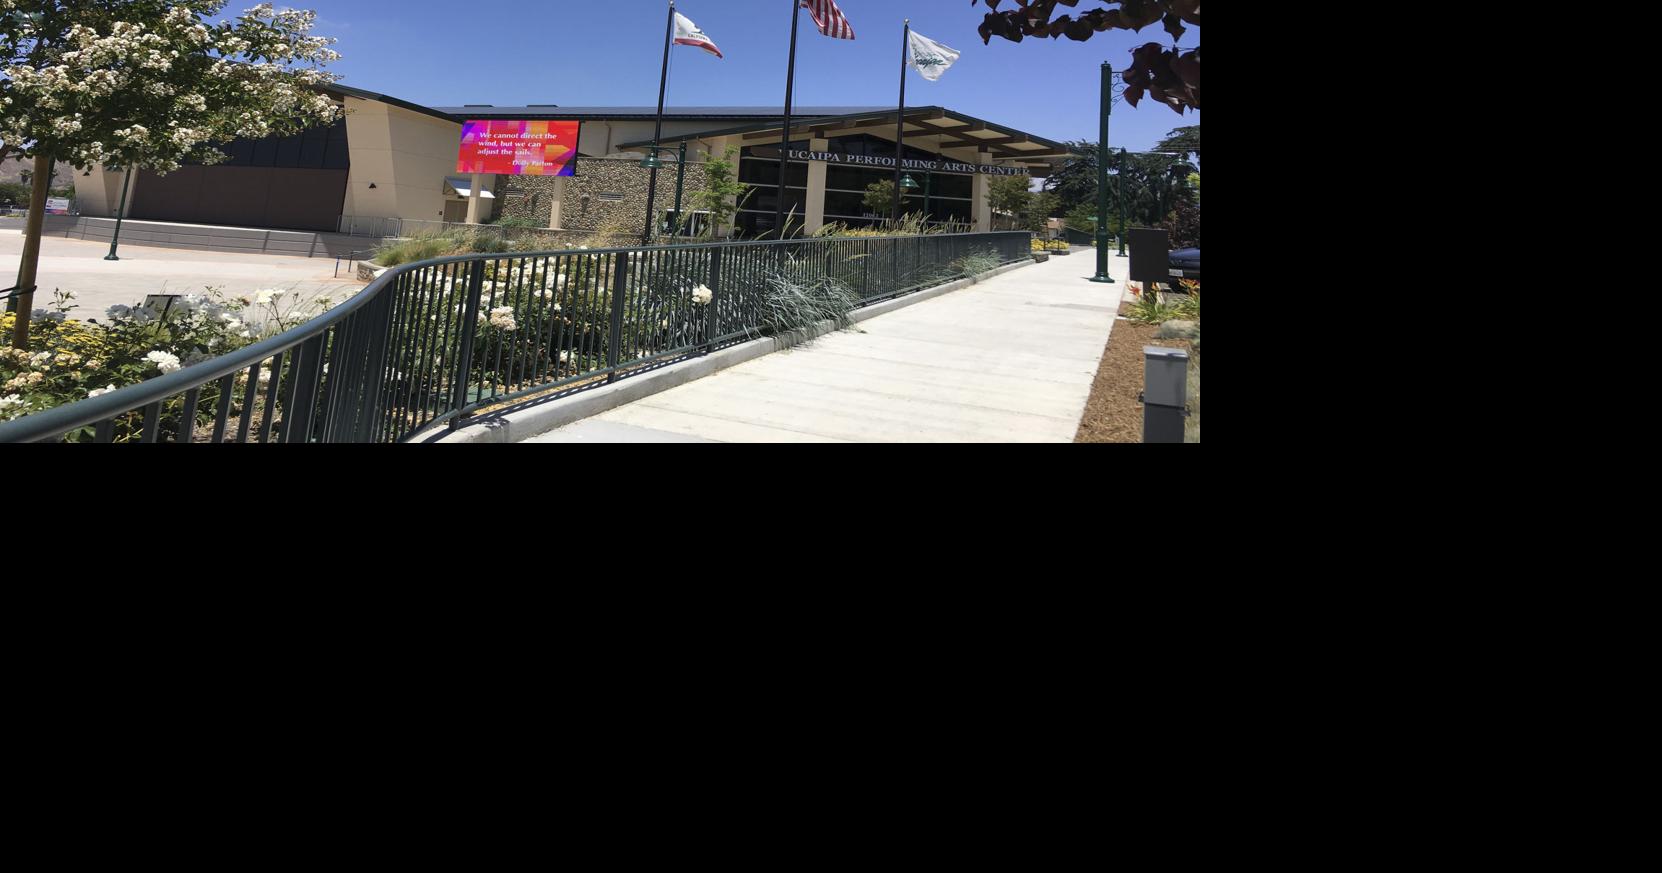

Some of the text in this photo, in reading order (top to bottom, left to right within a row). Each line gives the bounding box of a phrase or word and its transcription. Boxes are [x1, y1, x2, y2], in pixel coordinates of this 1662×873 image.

[477, 148, 499, 156] adjust
[512, 159, 529, 167] Dolly
[778, 149, 841, 162] UCAIPA
[942, 162, 976, 173] ARTS
[979, 165, 1030, 176] CENTER
